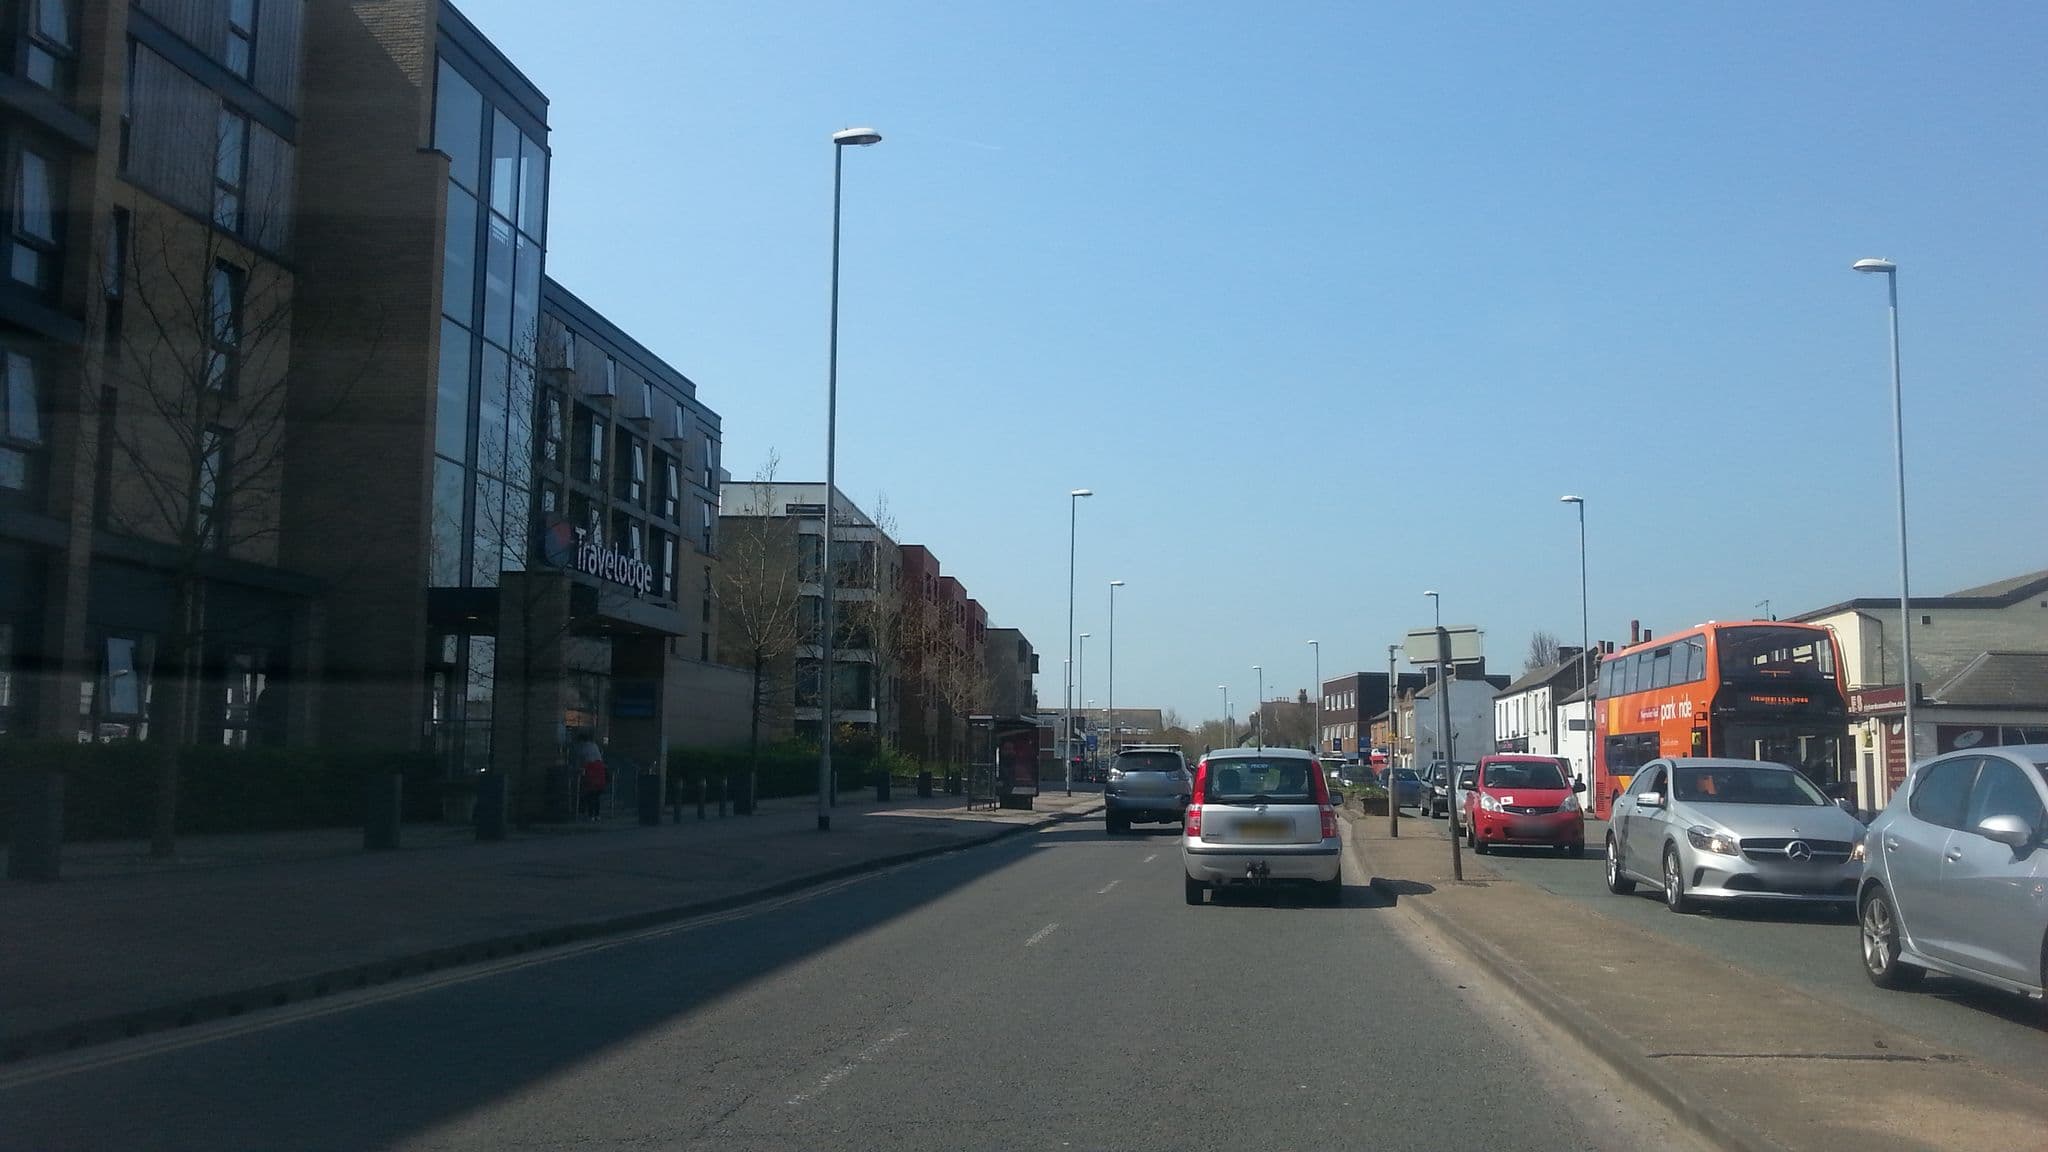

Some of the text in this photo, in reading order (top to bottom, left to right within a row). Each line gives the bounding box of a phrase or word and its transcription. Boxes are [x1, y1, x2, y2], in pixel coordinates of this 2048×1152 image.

[575, 526, 653, 598] Travelodge
[1660, 695, 1677, 727] park
[1678, 692, 1693, 719] ride
